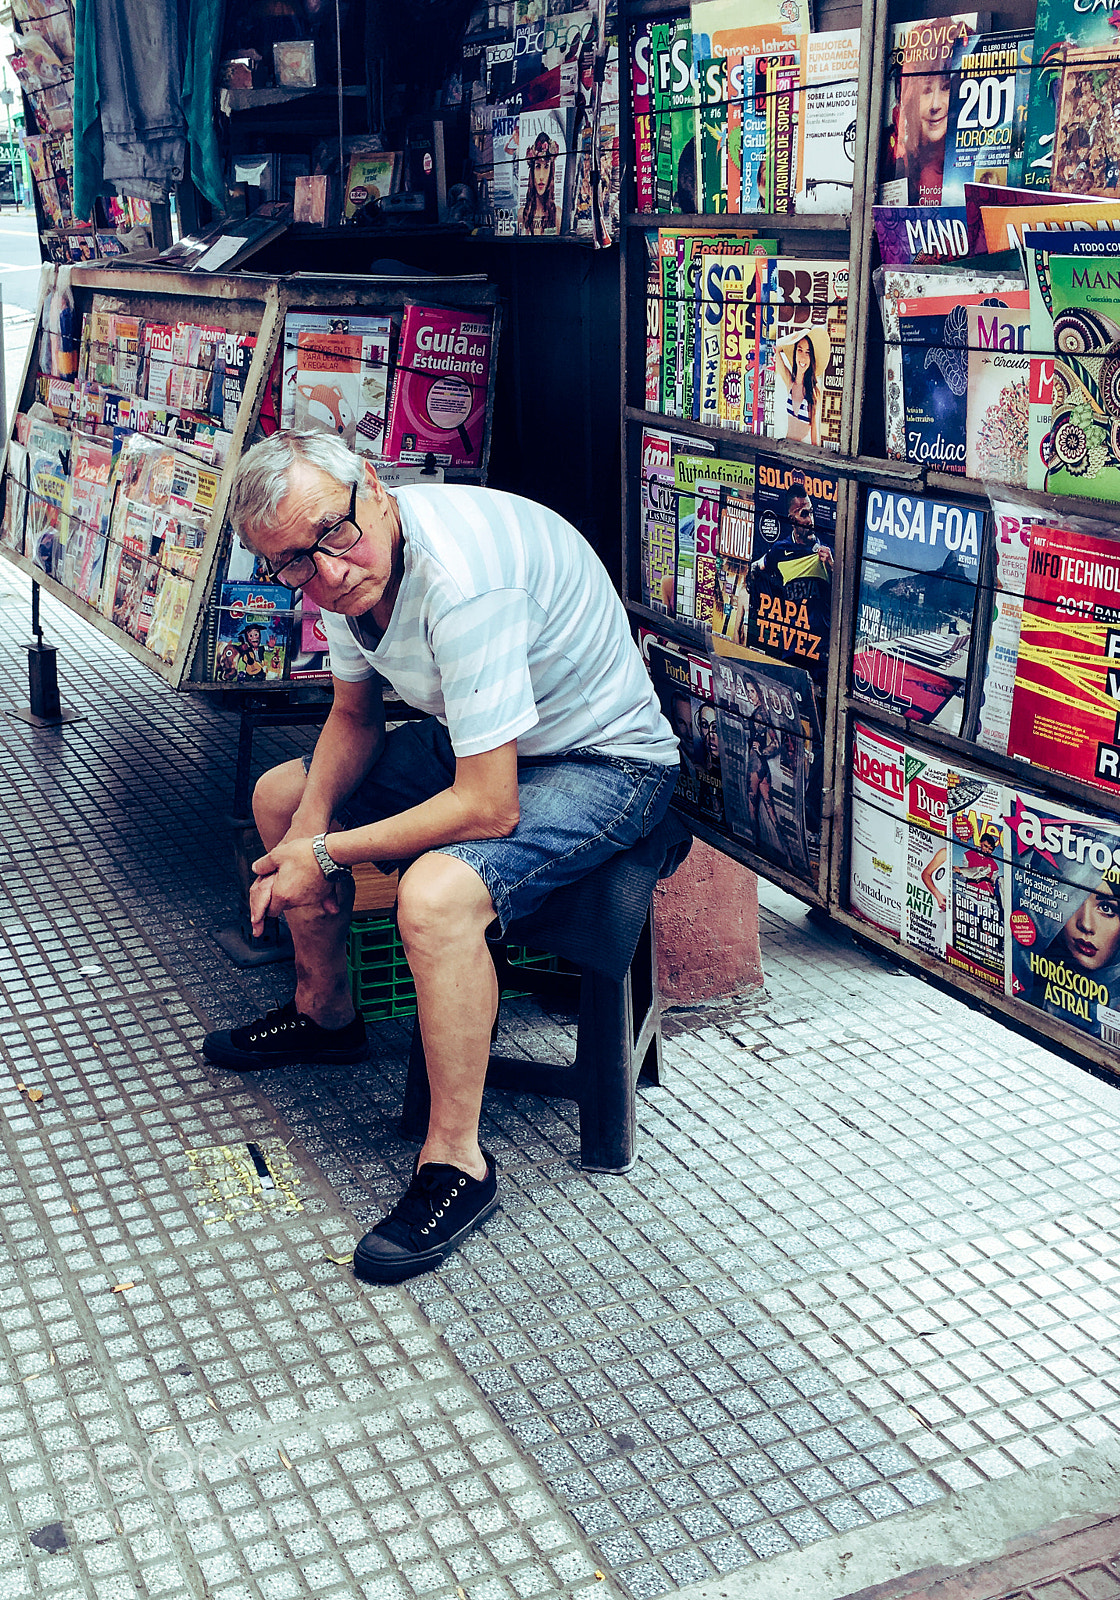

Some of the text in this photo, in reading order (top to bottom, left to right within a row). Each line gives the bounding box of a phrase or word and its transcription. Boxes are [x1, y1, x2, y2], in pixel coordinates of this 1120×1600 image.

[809, 39, 853, 52] BIBLIOTECA
[894, 22, 968, 50] LUDOVICA
[808, 64, 817, 73] DE
[820, 62, 829, 72] LA
[892, 47, 939, 65] SQUIRRU
[807, 92, 825, 101] SOBRE
[816, 101, 825, 109] UN
[826, 100, 848, 109] MUNDO
[957, 76, 1015, 129] 201
[710, 108, 721, 118] #16
[776, 96, 790, 196] PAGINAS DE SOPAS
[744, 161, 752, 202] Sopas
[905, 219, 969, 257] MAND
[1073, 242, 1105, 252] A TODO
[811, 271, 829, 325] CRUZADAS
[152, 331, 171, 349] mia
[200, 330, 225, 342] PRONTO
[416, 325, 486, 357] Guía del
[667, 322, 677, 341] DE
[303, 353, 321, 361] PARA
[308, 361, 339, 370] REGALAR
[413, 353, 484, 375] Estudiante
[666, 347, 676, 397] SOPAS
[759, 466, 793, 490] SOLO
[866, 490, 978, 555] CASA FOA
[1033, 536, 1047, 547] MIT
[958, 555, 978, 566] REVISTA
[1031, 550, 1120, 593] INFOTECHNOL
[1002, 569, 1019, 578] EDAD
[758, 591, 810, 630] PAPÁ
[862, 604, 881, 623] VIVIR
[1055, 595, 1094, 619] 2017
[757, 620, 822, 660] TEVEZ
[860, 618, 888, 640] BAJO EL
[855, 636, 912, 707] SOL
[909, 825, 932, 844] ENVIDIA
[854, 873, 901, 911] Contadores
[906, 882, 933, 906] DIETA
[1015, 871, 1023, 882] de
[1024, 873, 1032, 886] los
[1034, 881, 1053, 895] astros
[1054, 889, 1068, 901] para
[1025, 887, 1057, 909] el próximo
[906, 896, 933, 917] ANTI
[956, 893, 999, 922] Guía para
[1020, 898, 1062, 923] período anual
[956, 906, 980, 926] tener
[982, 918, 1004, 937] éxito
[956, 922, 967, 936] en
[969, 926, 977, 939] el
[980, 931, 998, 947] mar
[975, 968, 999, 985] AVENTURA
[1012, 979, 1021, 991] 4
[1030, 951, 1109, 1006] HORÓSCOPO
[1044, 982, 1093, 1023] ASTRAL
